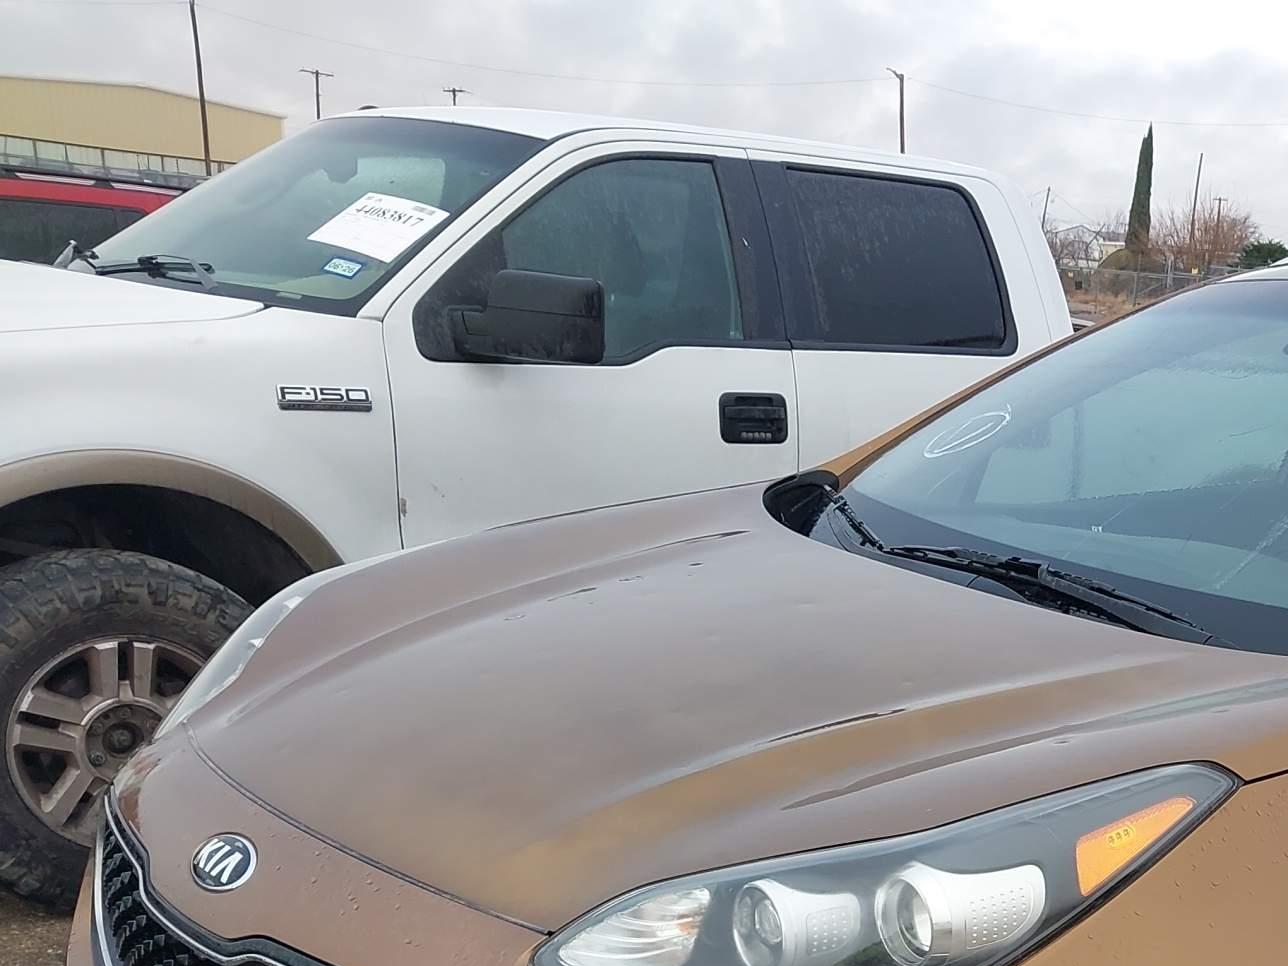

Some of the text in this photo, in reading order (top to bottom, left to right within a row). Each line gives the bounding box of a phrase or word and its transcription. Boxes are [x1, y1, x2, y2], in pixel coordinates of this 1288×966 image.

[355, 204, 424, 227] 44083817
[278, 386, 371, 403] F-150
[193, 838, 243, 884] KIA
